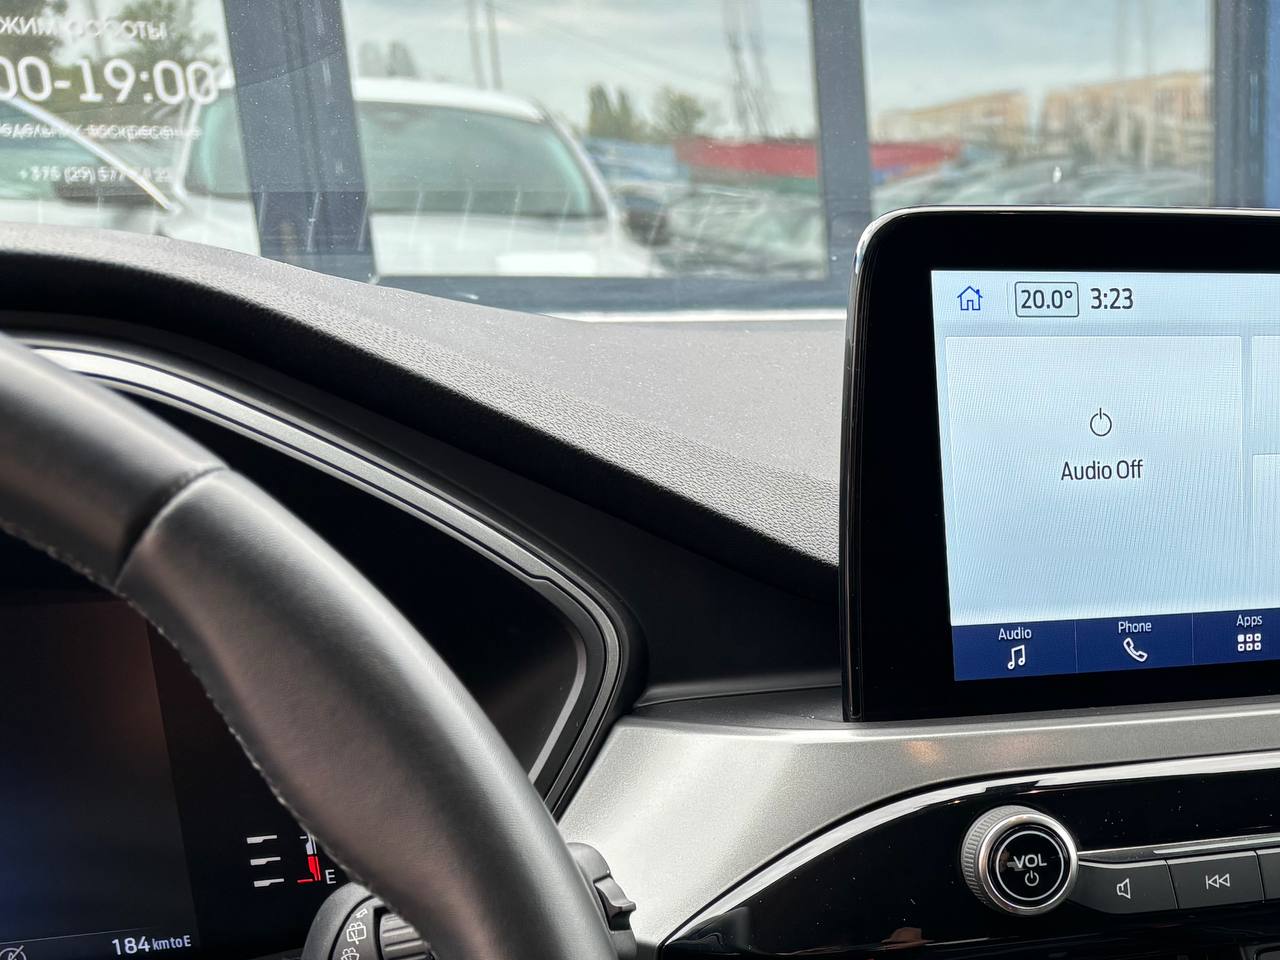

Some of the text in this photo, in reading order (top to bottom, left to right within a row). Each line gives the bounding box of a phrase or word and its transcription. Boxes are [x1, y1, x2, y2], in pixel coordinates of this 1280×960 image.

[1021, 287, 1134, 310] 20.0° 3:23
[1060, 459, 1144, 481] Audio Off
[1118, 621, 1152, 634] Phone
[1236, 614, 1263, 627] Apps
[998, 627, 1032, 641] Audio
[1013, 853, 1048, 869] VOL
[325, 869, 336, 884] E
[111, 936, 151, 956] 184
